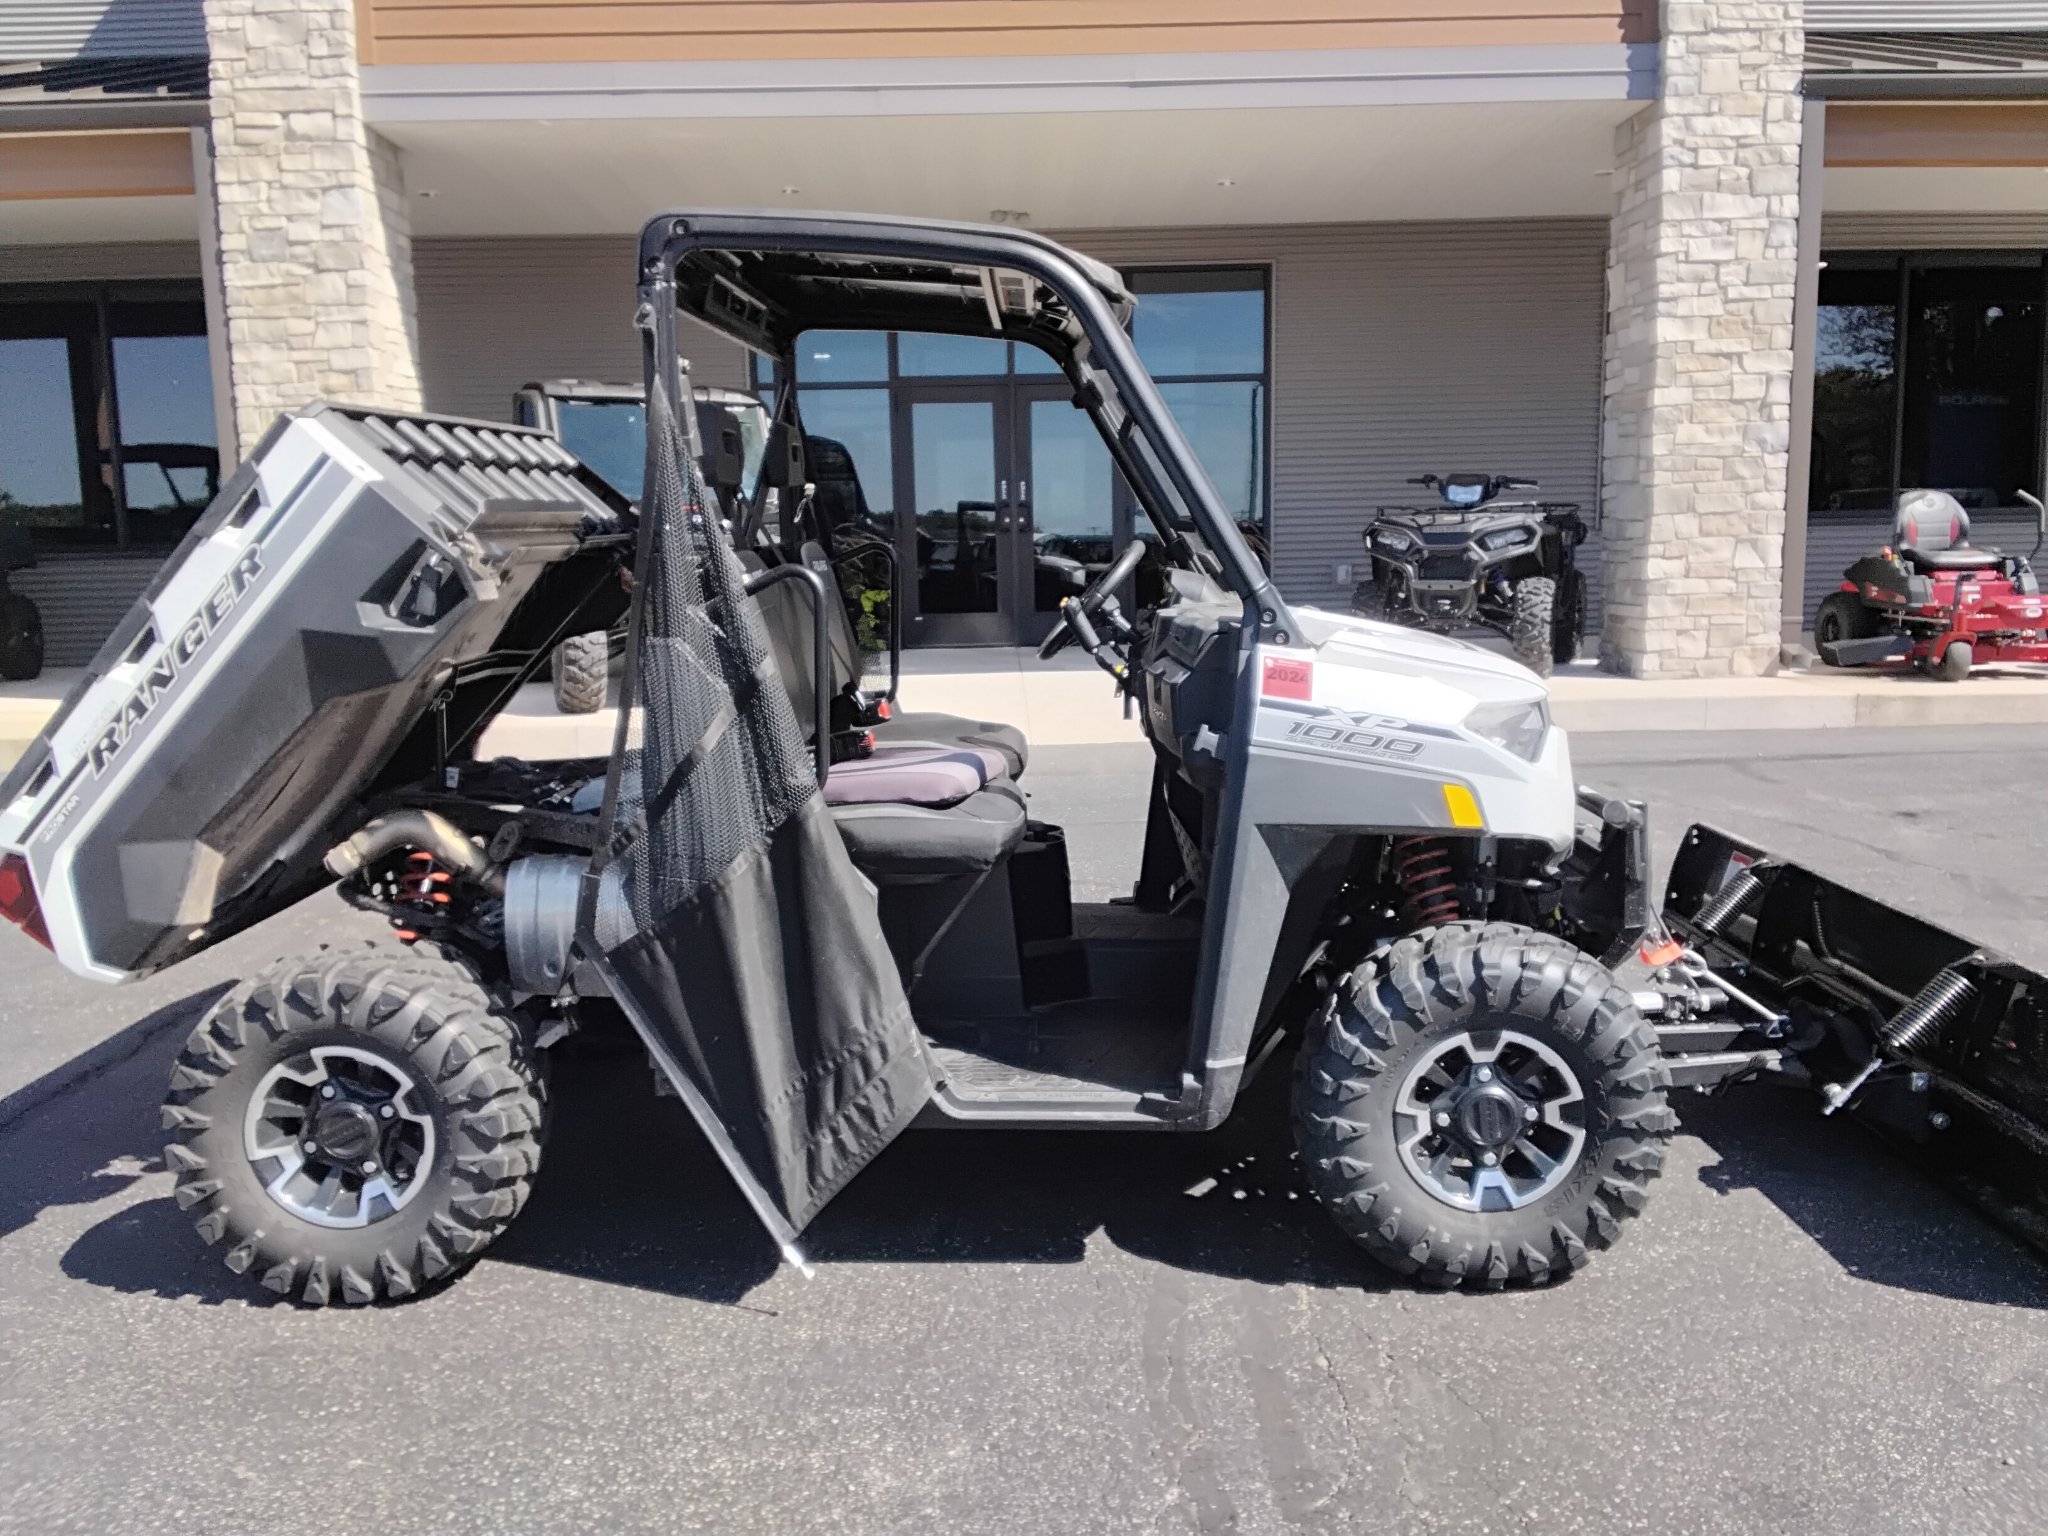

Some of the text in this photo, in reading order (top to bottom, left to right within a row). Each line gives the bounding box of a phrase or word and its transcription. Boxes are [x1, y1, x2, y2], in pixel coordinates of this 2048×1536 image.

[87, 543, 266, 780] RANGER
[1266, 667, 1309, 684] 2024
[1312, 705, 1409, 729] XP
[1285, 737, 1416, 763] DUAL OVERHEAD CAM
[1287, 721, 1426, 756] 1000
